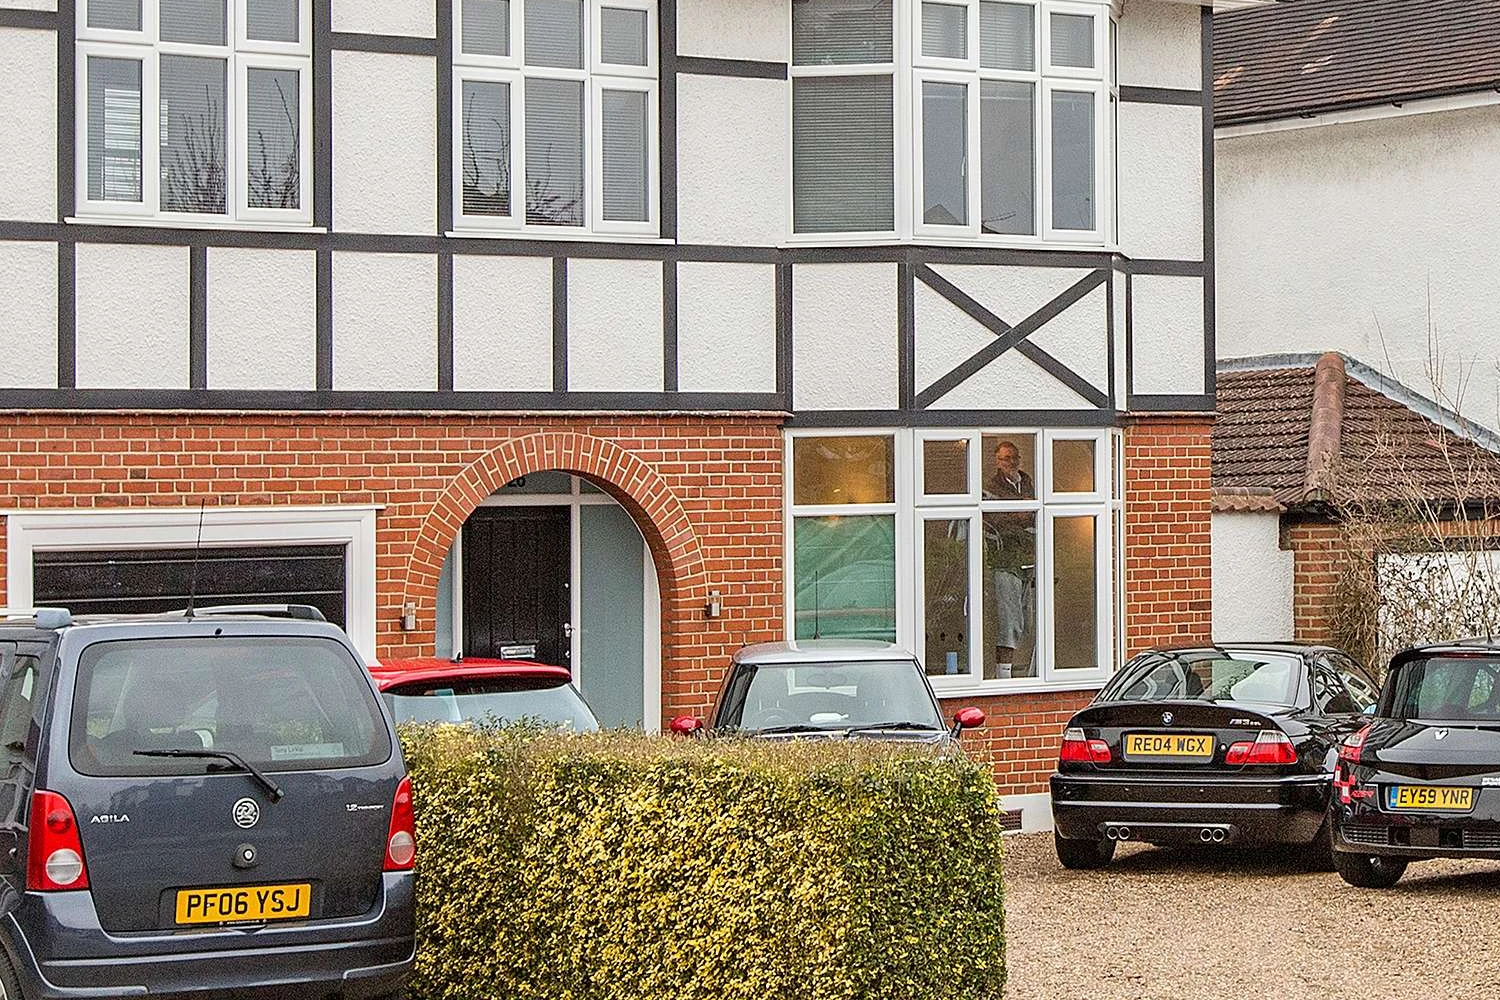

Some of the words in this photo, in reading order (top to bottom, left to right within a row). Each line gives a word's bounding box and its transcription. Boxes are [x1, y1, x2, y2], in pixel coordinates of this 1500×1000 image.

[1133, 737, 1172, 752] RE04
[1176, 737, 1206, 753] WGX
[1400, 788, 1437, 804] EY59
[1441, 789, 1470, 805] YNR
[187, 891, 249, 918] PF06
[256, 888, 300, 914] YSJ
